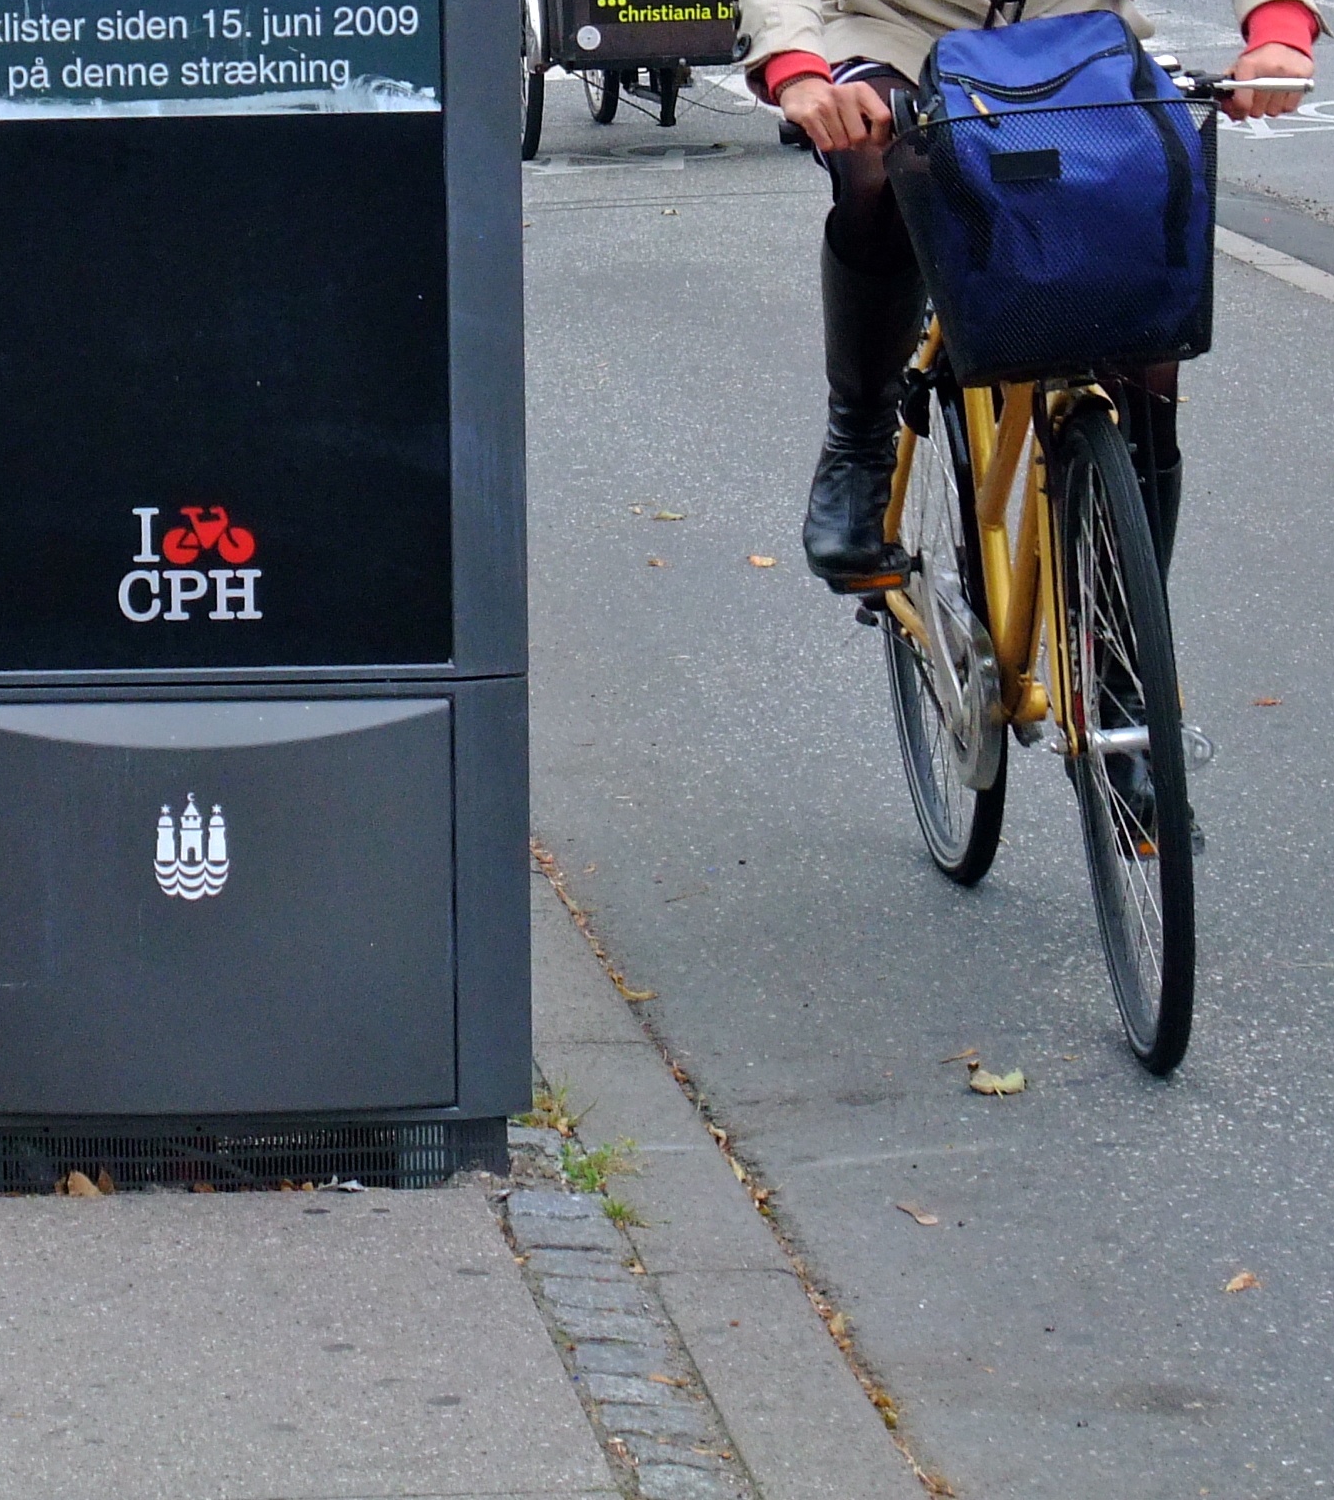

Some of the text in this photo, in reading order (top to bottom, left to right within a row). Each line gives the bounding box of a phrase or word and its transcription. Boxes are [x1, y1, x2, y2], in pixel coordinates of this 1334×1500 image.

[97, 10, 189, 41] siden
[203, 9, 251, 39] 15.
[262, 7, 321, 44] juni
[334, 6, 419, 36] 2009
[619, 4, 711, 23] christiania
[8, 54, 350, 95] på denne strækning
[132, 507, 160, 562] I
[118, 569, 263, 622] CPH
